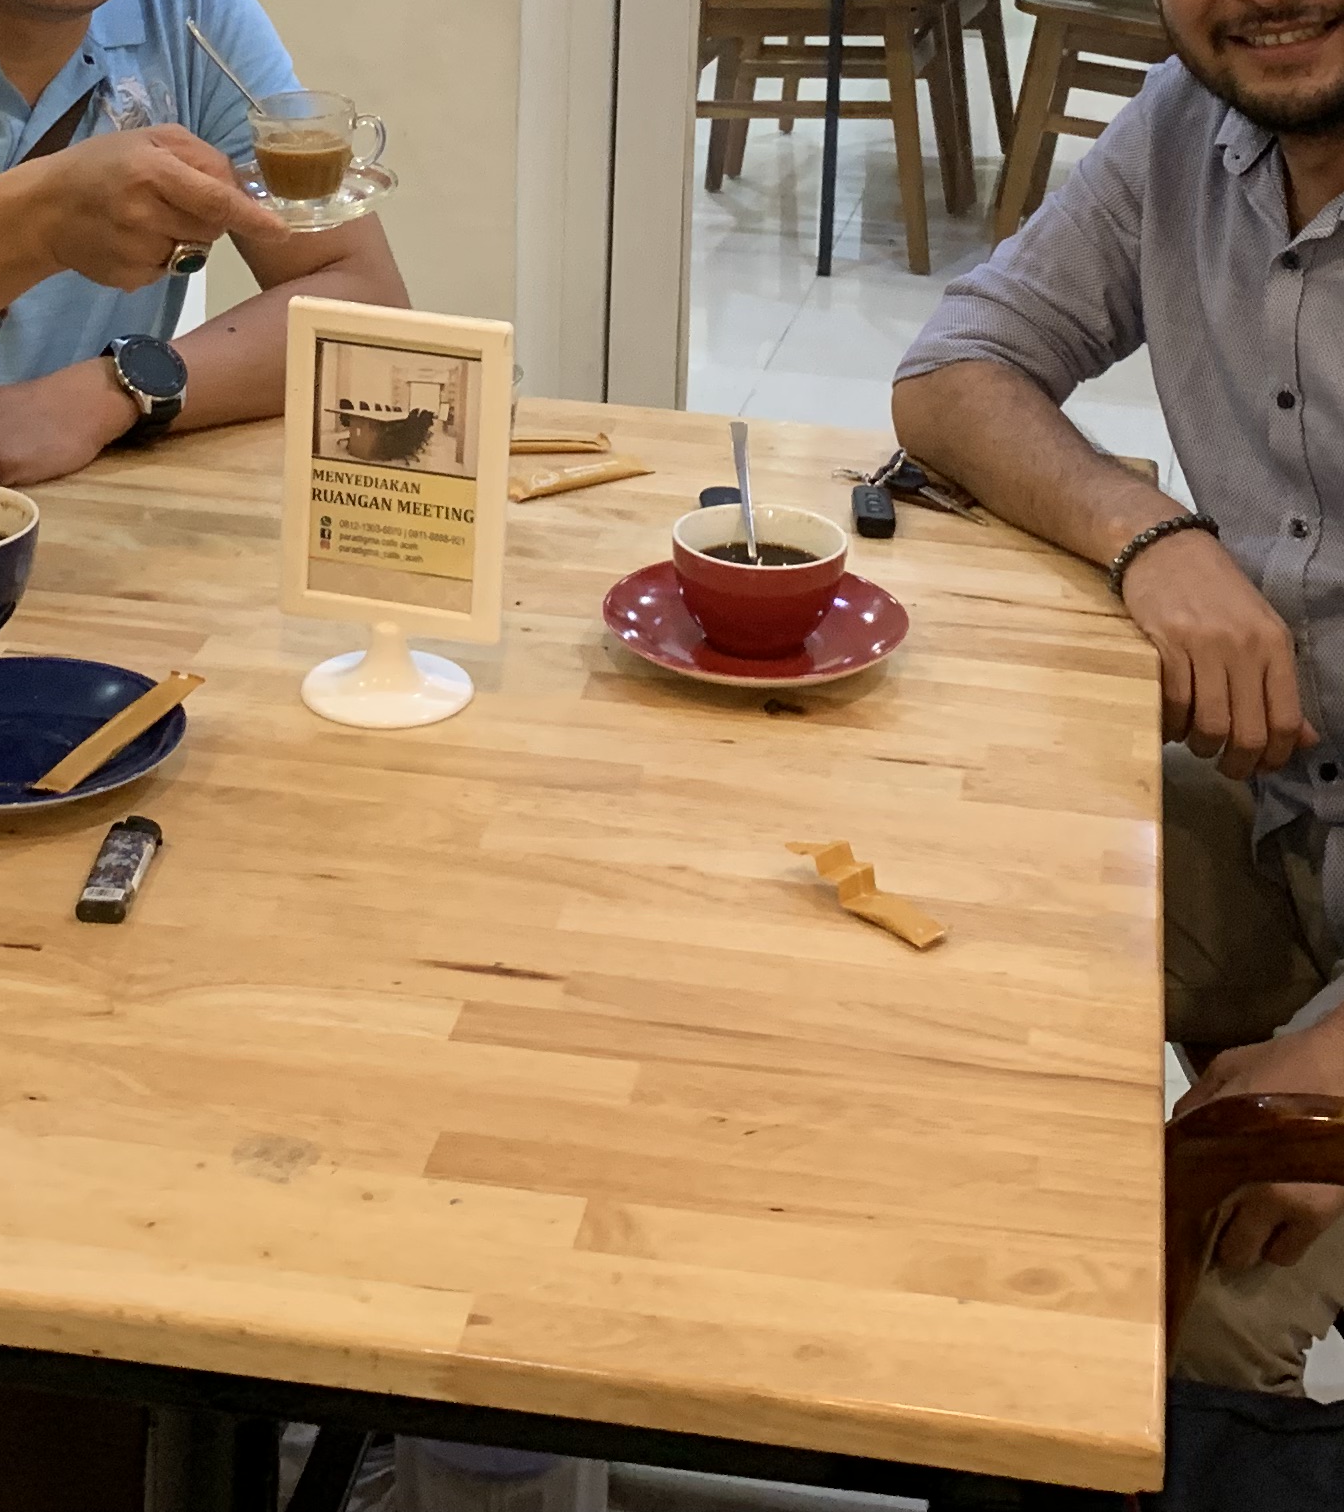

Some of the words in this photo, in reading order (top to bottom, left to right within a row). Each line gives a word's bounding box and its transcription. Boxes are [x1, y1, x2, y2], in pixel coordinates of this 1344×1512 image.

[312, 468, 421, 495] MENYEDIAKAN
[311, 488, 392, 512] RUANGAN
[397, 499, 475, 524] MEETING
